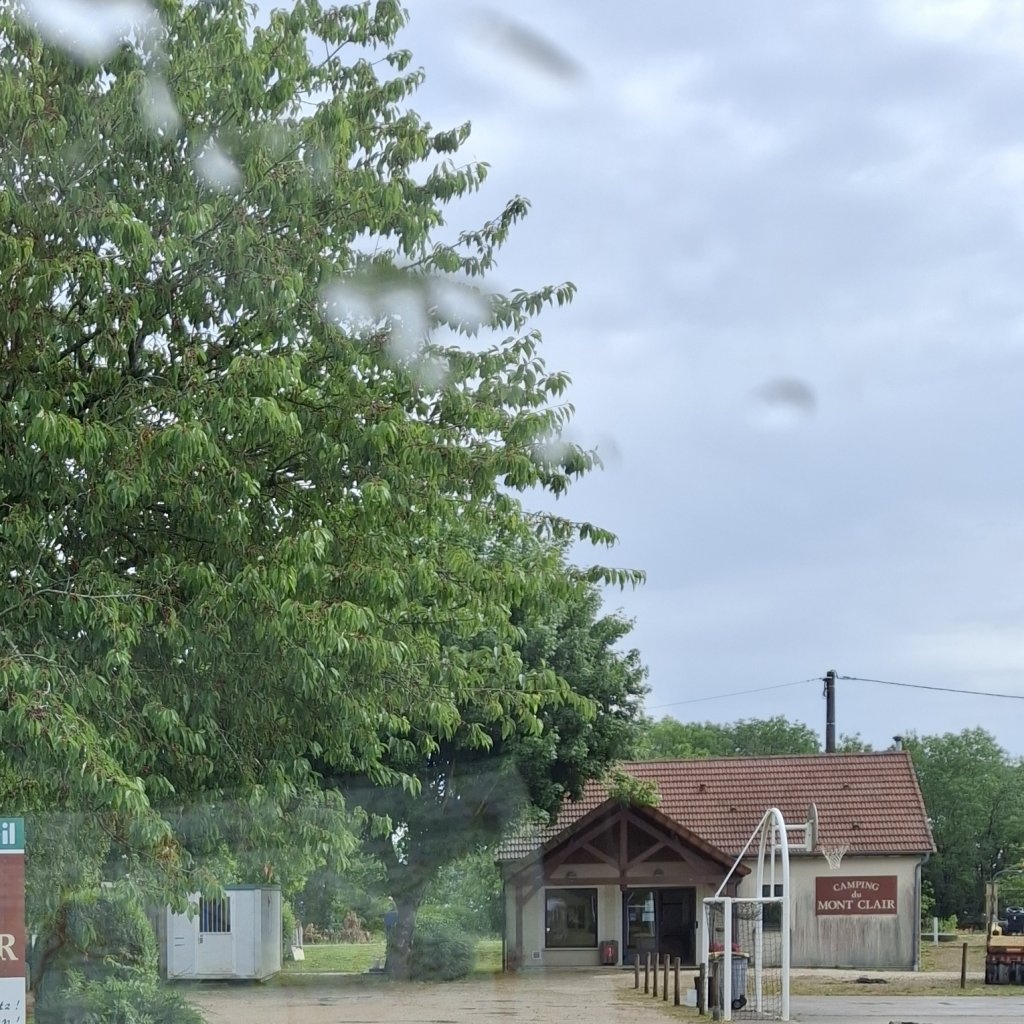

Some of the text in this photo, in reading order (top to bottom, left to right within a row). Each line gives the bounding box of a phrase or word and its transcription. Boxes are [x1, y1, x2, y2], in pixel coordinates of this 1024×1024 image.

[833, 881, 880, 892] CAMPING
[818, 899, 896, 911] MONT CLAIR
